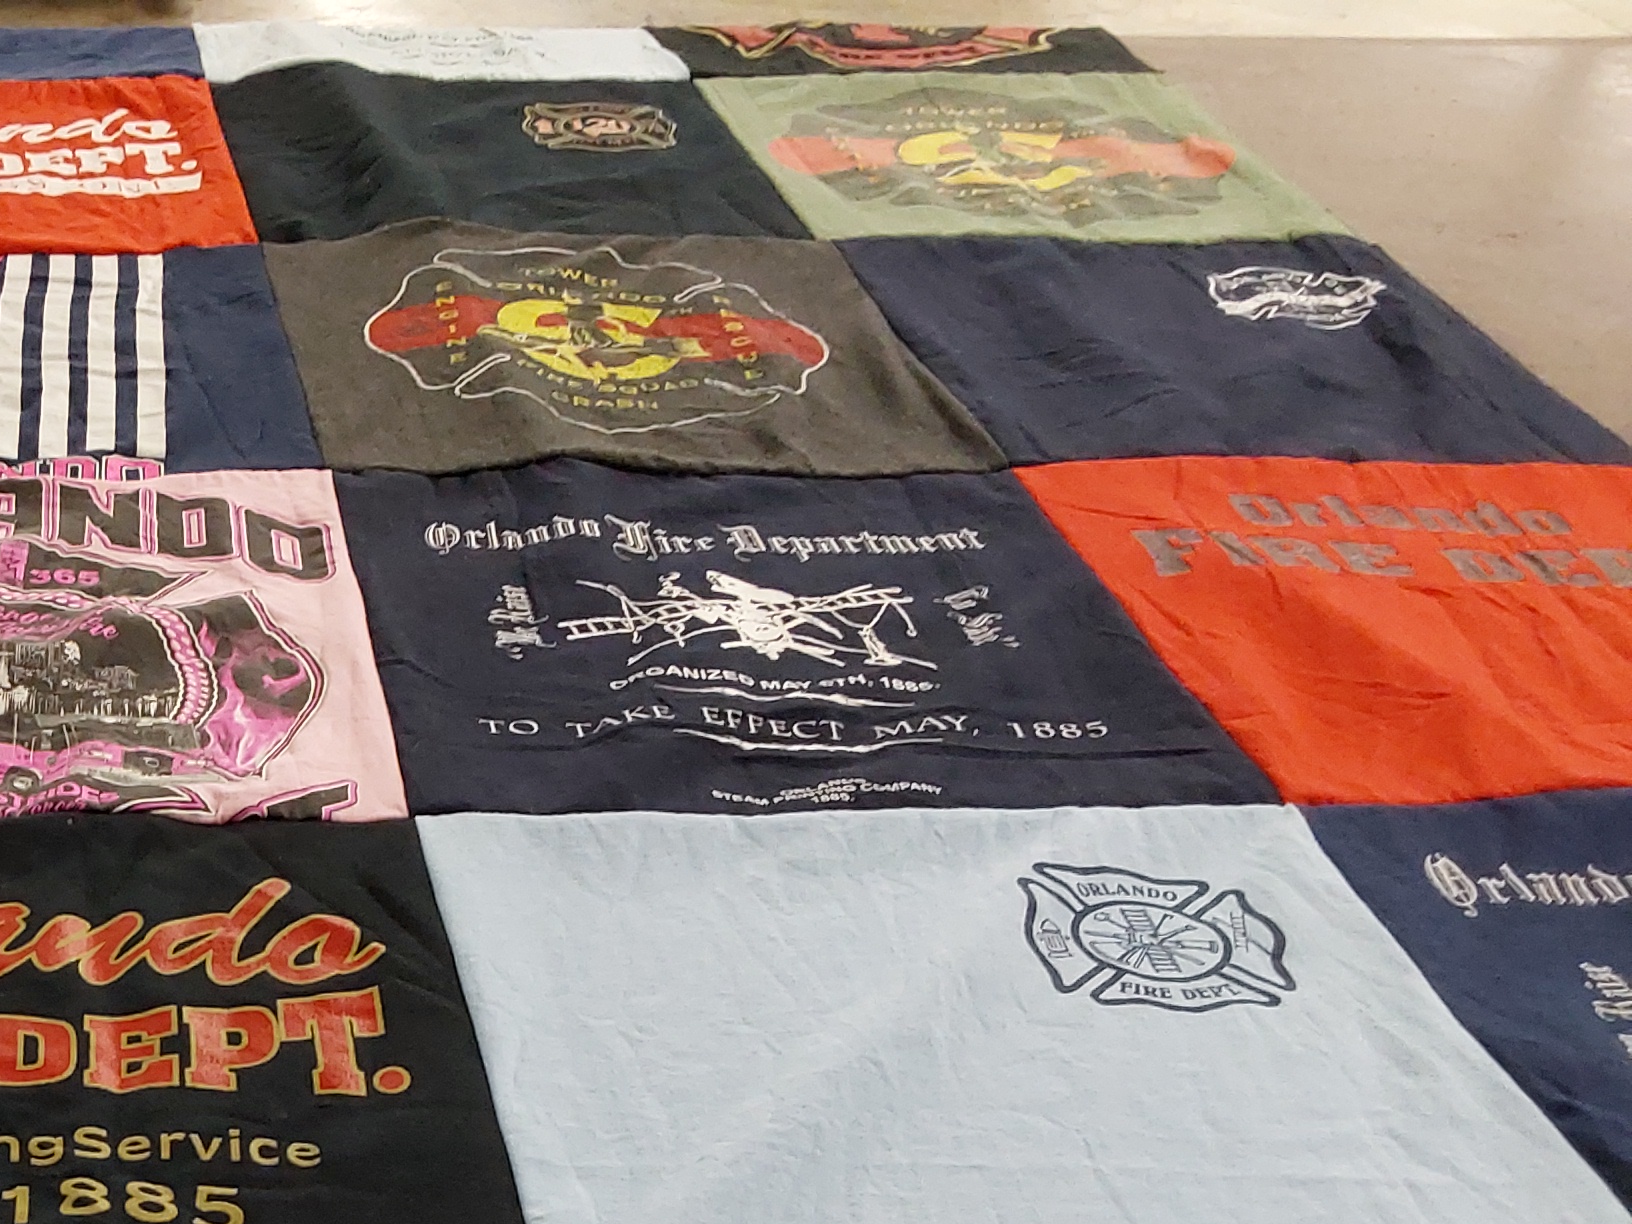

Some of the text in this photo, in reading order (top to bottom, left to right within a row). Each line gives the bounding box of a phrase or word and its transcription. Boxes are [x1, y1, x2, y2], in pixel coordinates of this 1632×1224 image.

[1228, 493, 1572, 537] Orlando
[424, 511, 987, 563] Orlando Fire Department
[1130, 528, 1415, 578] FIRE
[609, 664, 755, 691] ORGANIZED
[759, 679, 813, 691] MAY
[478, 703, 1111, 742] TO TAKE EFFECT MAY, 1885
[711, 788, 770, 807] STEAM
[859, 781, 943, 796] COMPANY
[1075, 881, 1179, 902] ORLANDO
[1423, 852, 1632, 918] Orland
[1118, 981, 1242, 1001] FIRE DEPT
